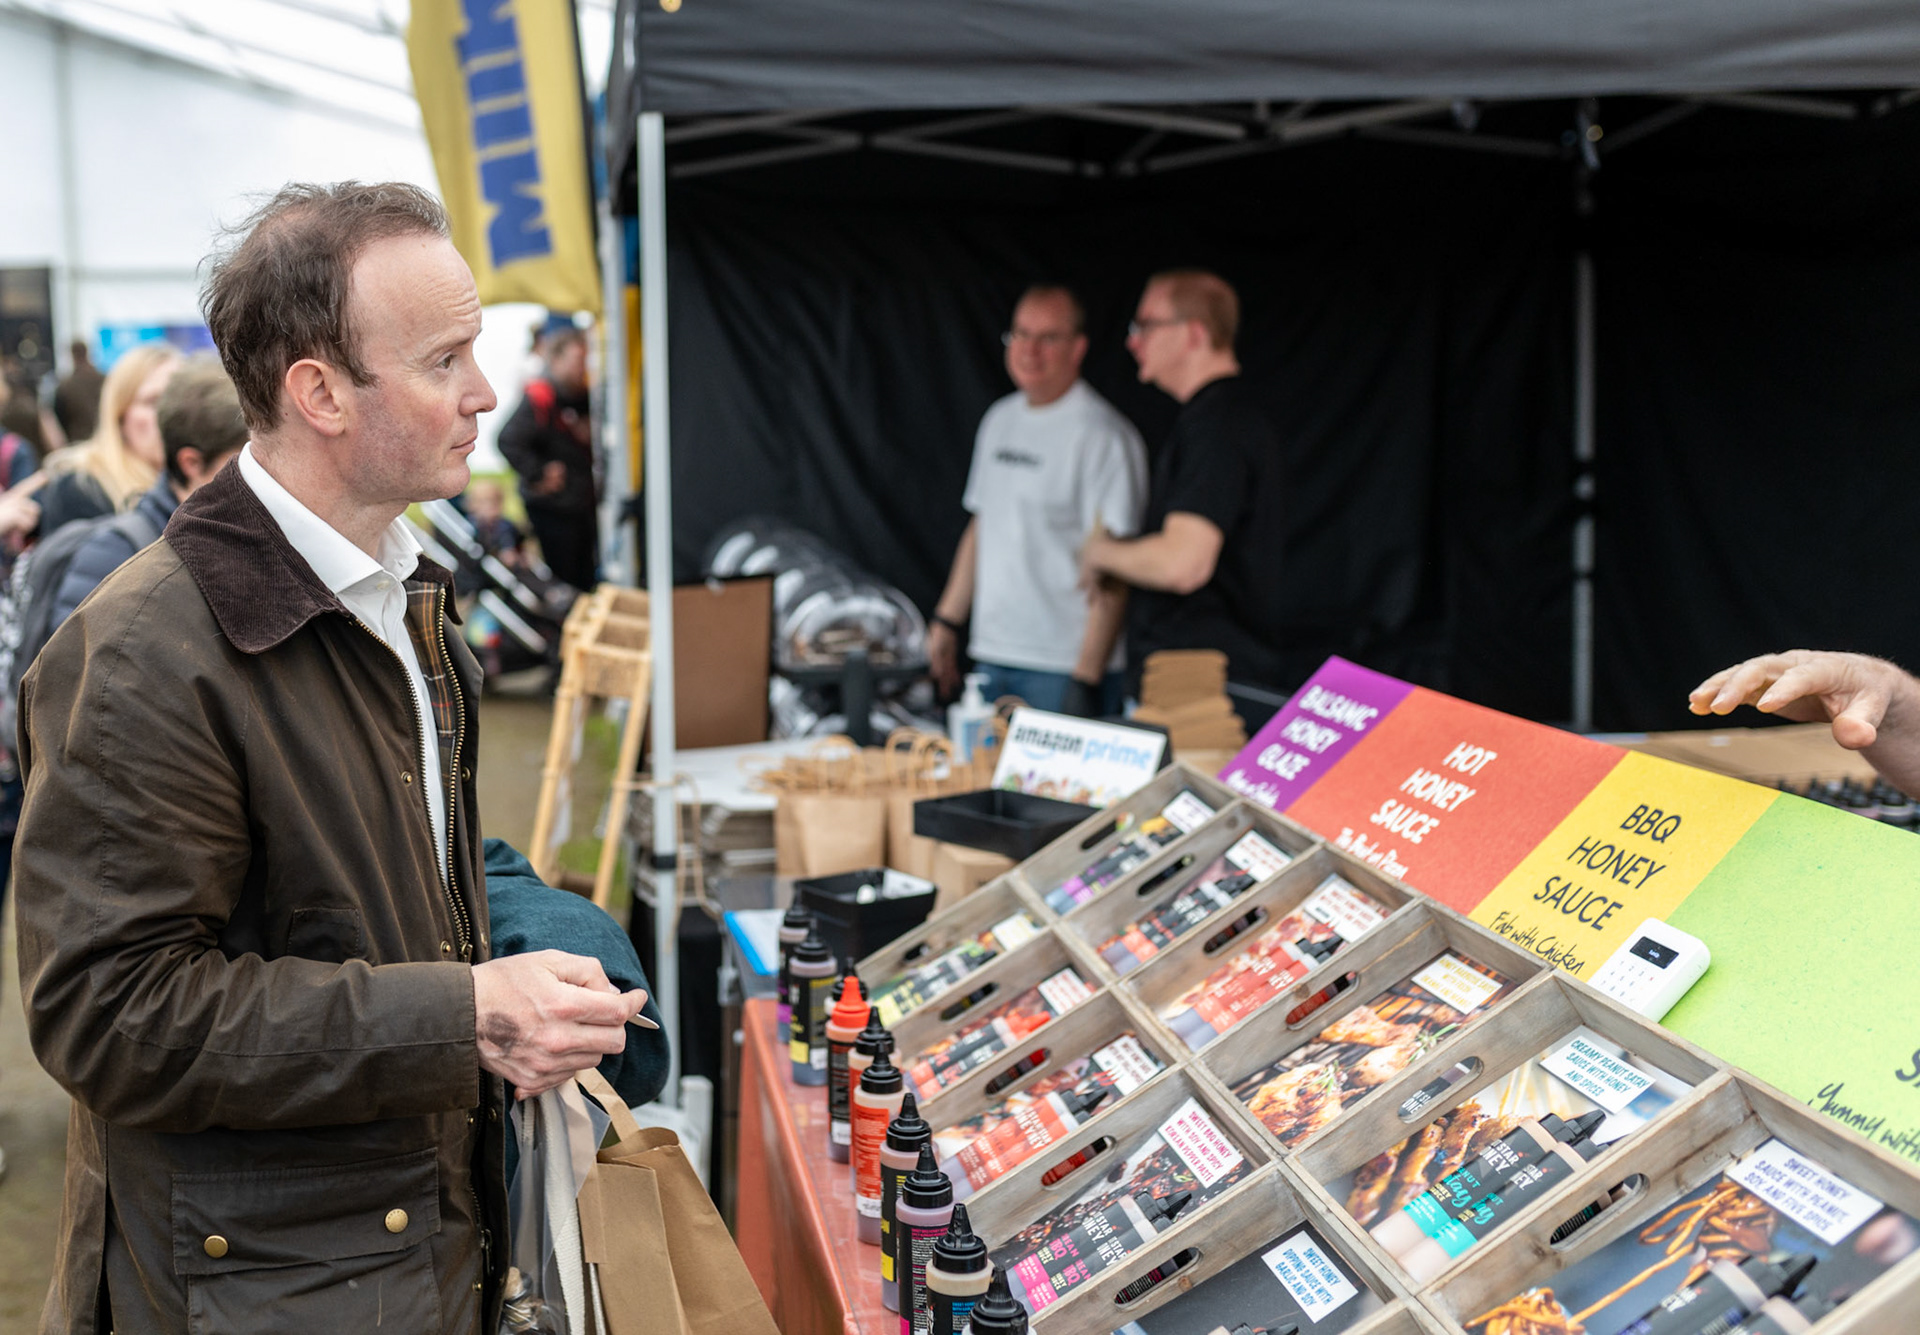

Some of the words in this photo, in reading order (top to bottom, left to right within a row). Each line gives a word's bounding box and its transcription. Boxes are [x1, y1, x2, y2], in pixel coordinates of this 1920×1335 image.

[1299, 684, 1379, 732] BALSAMIC
[1014, 725, 1083, 755] amazon
[1081, 735, 1152, 771] prime
[1280, 715, 1342, 755] HONEY
[1257, 743, 1311, 781] GLAZE
[1442, 741, 1498, 776] HOT
[1399, 767, 1477, 812] HONEY
[1370, 799, 1440, 844] SAUCE
[1619, 803, 1682, 843] BBQ
[1566, 836, 1667, 889] HONEY
[1533, 876, 1624, 931] SAUCE
[1489, 911, 1519, 933] Fab
[1511, 925, 1540, 950] with
[1535, 936, 1585, 975] Chicken
[1564, 1070, 1584, 1083] AND
[1582, 1078, 1605, 1097] SPICES
[1566, 1052, 1592, 1070] SAUCE
[1586, 1065, 1608, 1081] WITH
[1605, 1075, 1632, 1094] HONEY
[1570, 1040, 1604, 1061] CREAMY
[1598, 1056, 1630, 1077] PEANUT
[1623, 1071, 1651, 1089] SATAY
[1808, 1082, 1887, 1140] Yummy
[1164, 1125, 1186, 1149] KOREAN
[1181, 1145, 1202, 1166] PEPPER
[1196, 1163, 1215, 1183] PASTE
[1176, 1118, 1193, 1134] WITH
[1188, 1131, 1202, 1145] SOY
[1197, 1143, 1211, 1156] AND
[1206, 1153, 1224, 1171] SPICY
[1188, 1111, 1207, 1131] SWEET
[1203, 1128, 1218, 1143] BBQ
[1212, 1138, 1233, 1159] HONEY
[1744, 1171, 1766, 1188] SOY
[1764, 1184, 1788, 1201] AND
[1781, 1195, 1806, 1215] FIVE
[1802, 1209, 1835, 1232] SPICE
[1755, 1160, 1788, 1183] SAUCE
[1782, 1176, 1813, 1199] WITH
[1784, 1157, 1819, 1182] SWEET
[1814, 1175, 1853, 1201] HONEY
[1275, 1261, 1298, 1284] GARLIC
[1291, 1281, 1307, 1296] AND
[1300, 1292, 1317, 1307] SOY
[1282, 1248, 1306, 1273] DIPPING
[1300, 1269, 1322, 1290] SAUCE
[1314, 1285, 1335, 1306] WITH
[1303, 1247, 1325, 1269] SWEET
[1318, 1264, 1342, 1286] HONEY
